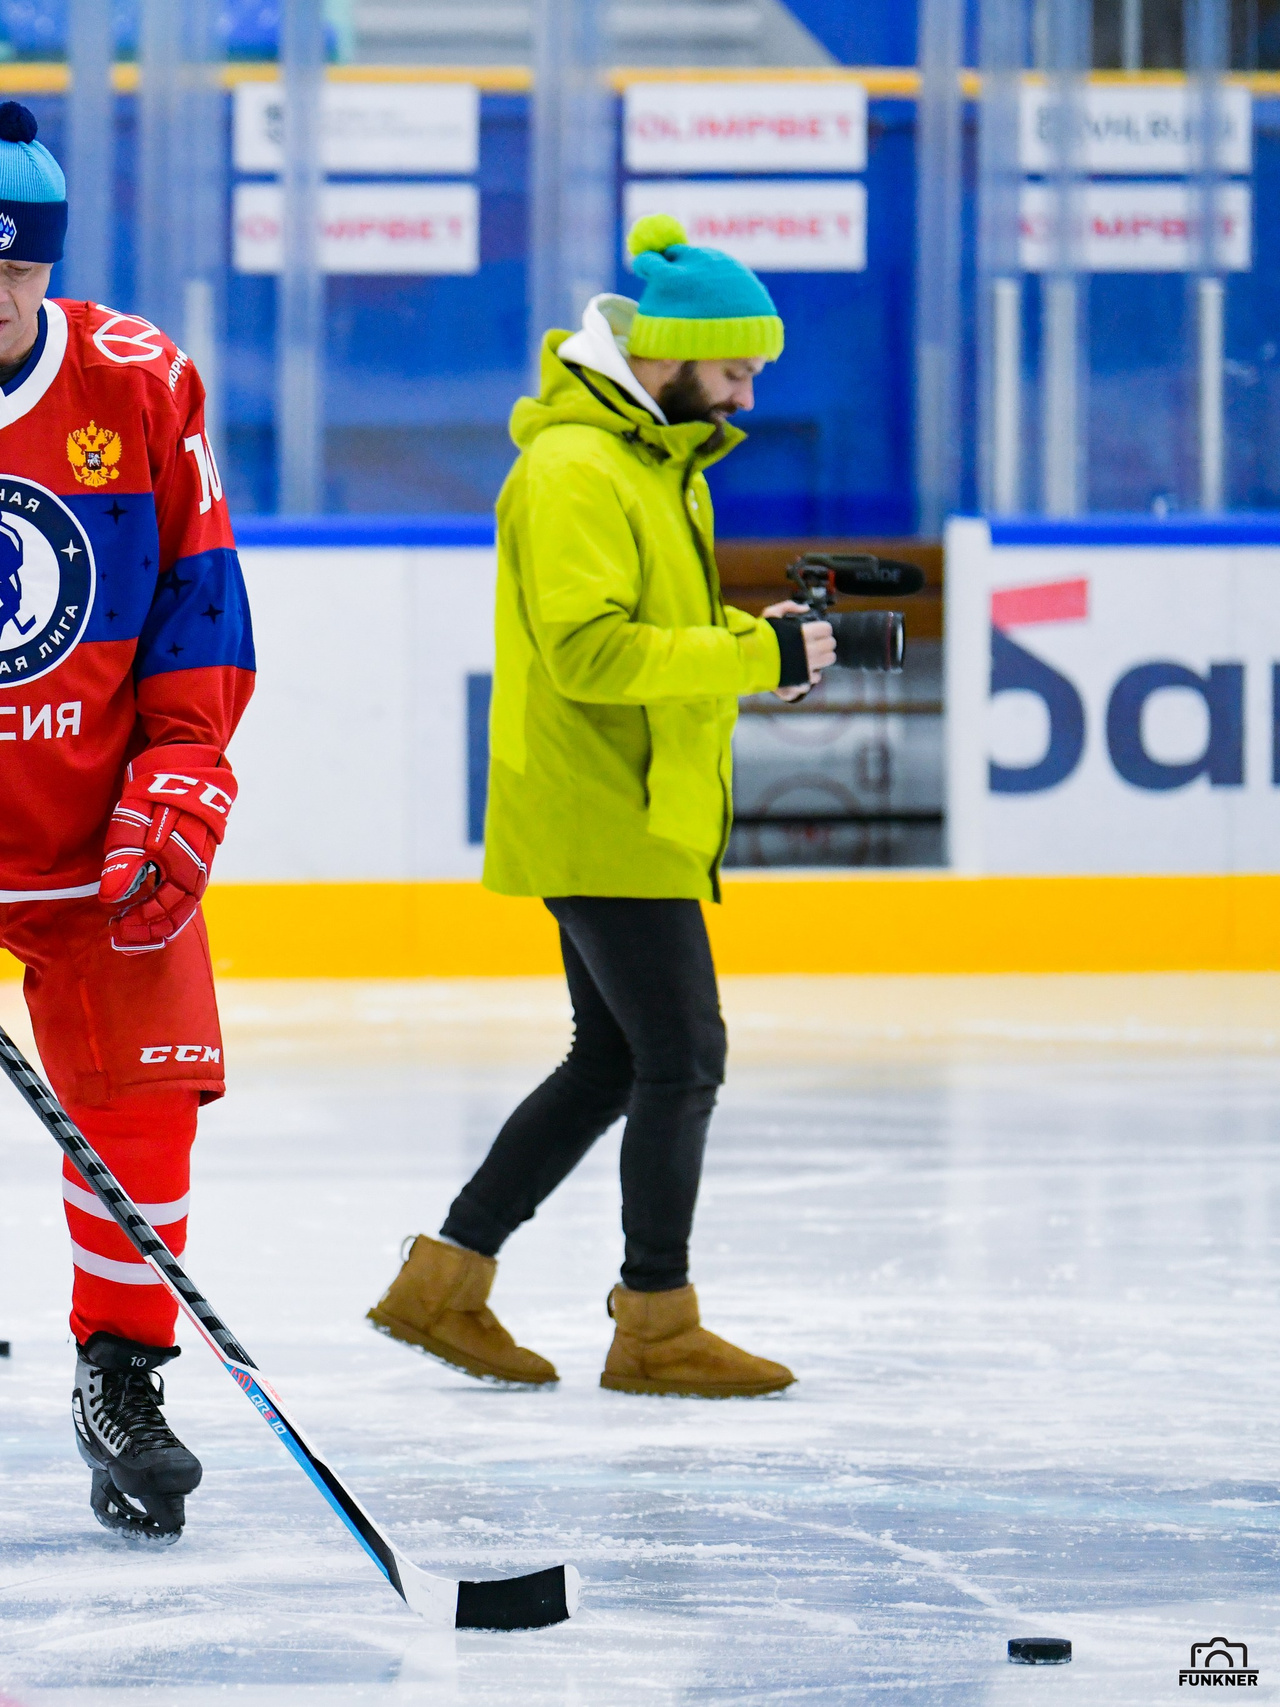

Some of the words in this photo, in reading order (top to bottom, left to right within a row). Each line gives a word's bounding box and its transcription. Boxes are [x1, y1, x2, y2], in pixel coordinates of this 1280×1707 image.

[183, 428, 223, 515] 10
[38, 604, 79, 659] ЛИГА
[988, 578, 1280, 796] ба
[101, 863, 129, 877] CCM
[139, 1045, 220, 1064] CCM
[131, 1356, 147, 1367] 10
[251, 1394, 277, 1421] QRE
[272, 1420, 288, 1435] 10
